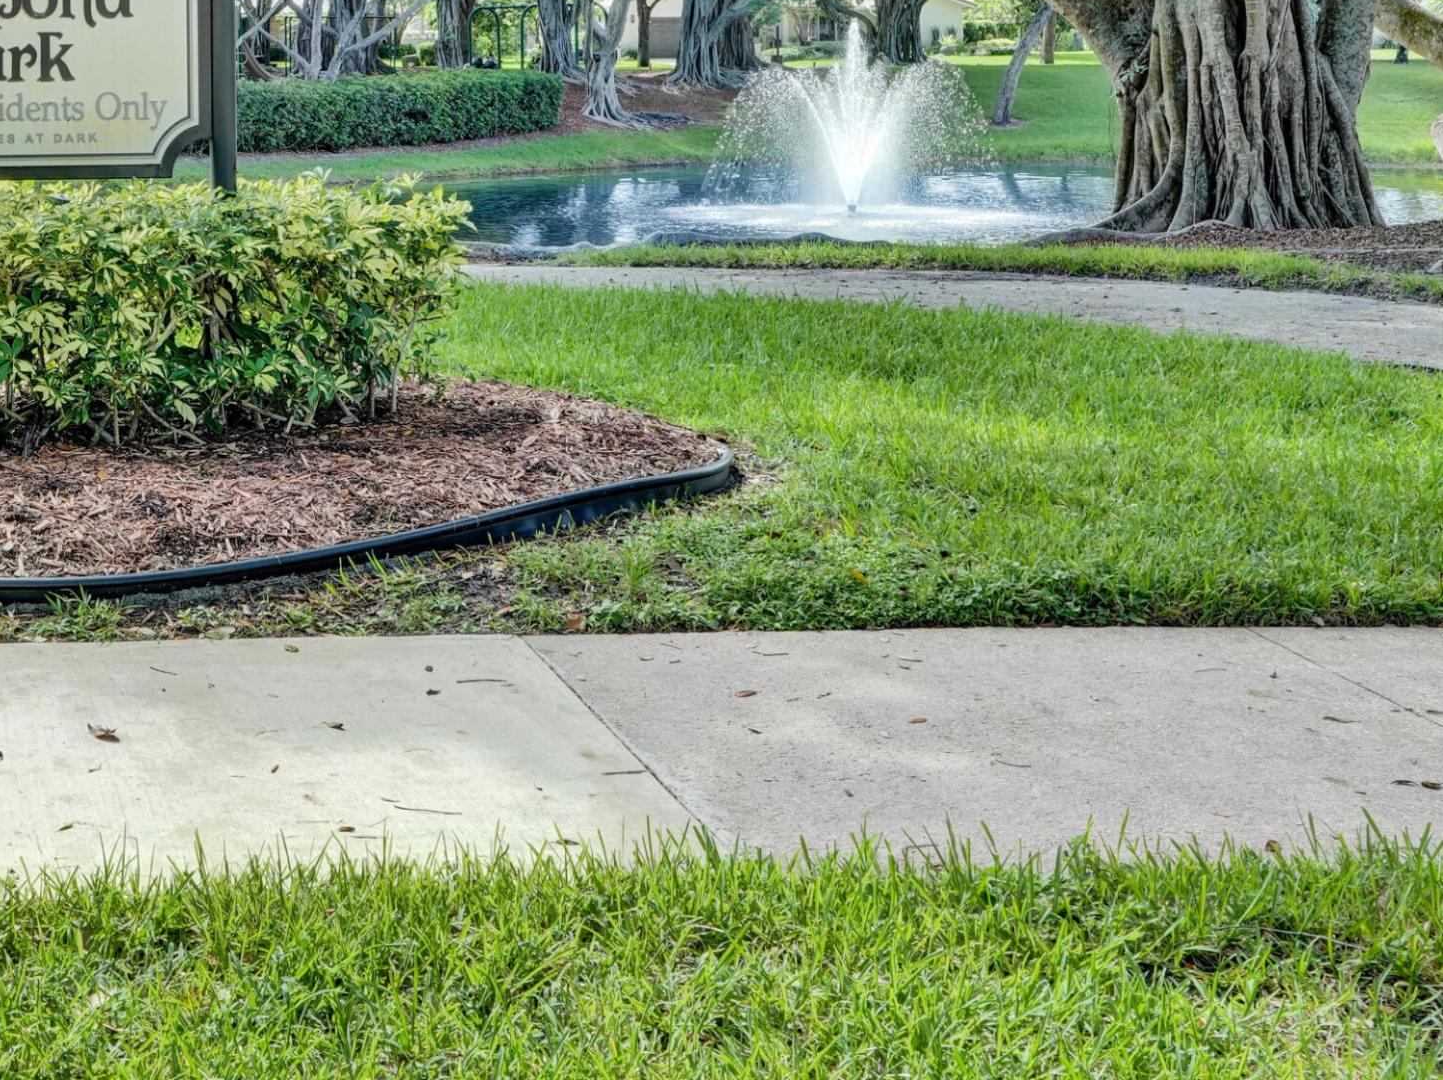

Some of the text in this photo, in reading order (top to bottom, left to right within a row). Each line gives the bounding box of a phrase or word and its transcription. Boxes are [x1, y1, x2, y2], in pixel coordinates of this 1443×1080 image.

[95, 91, 168, 131] Only
[24, 133, 44, 144] AT
[53, 132, 98, 144] DARK
